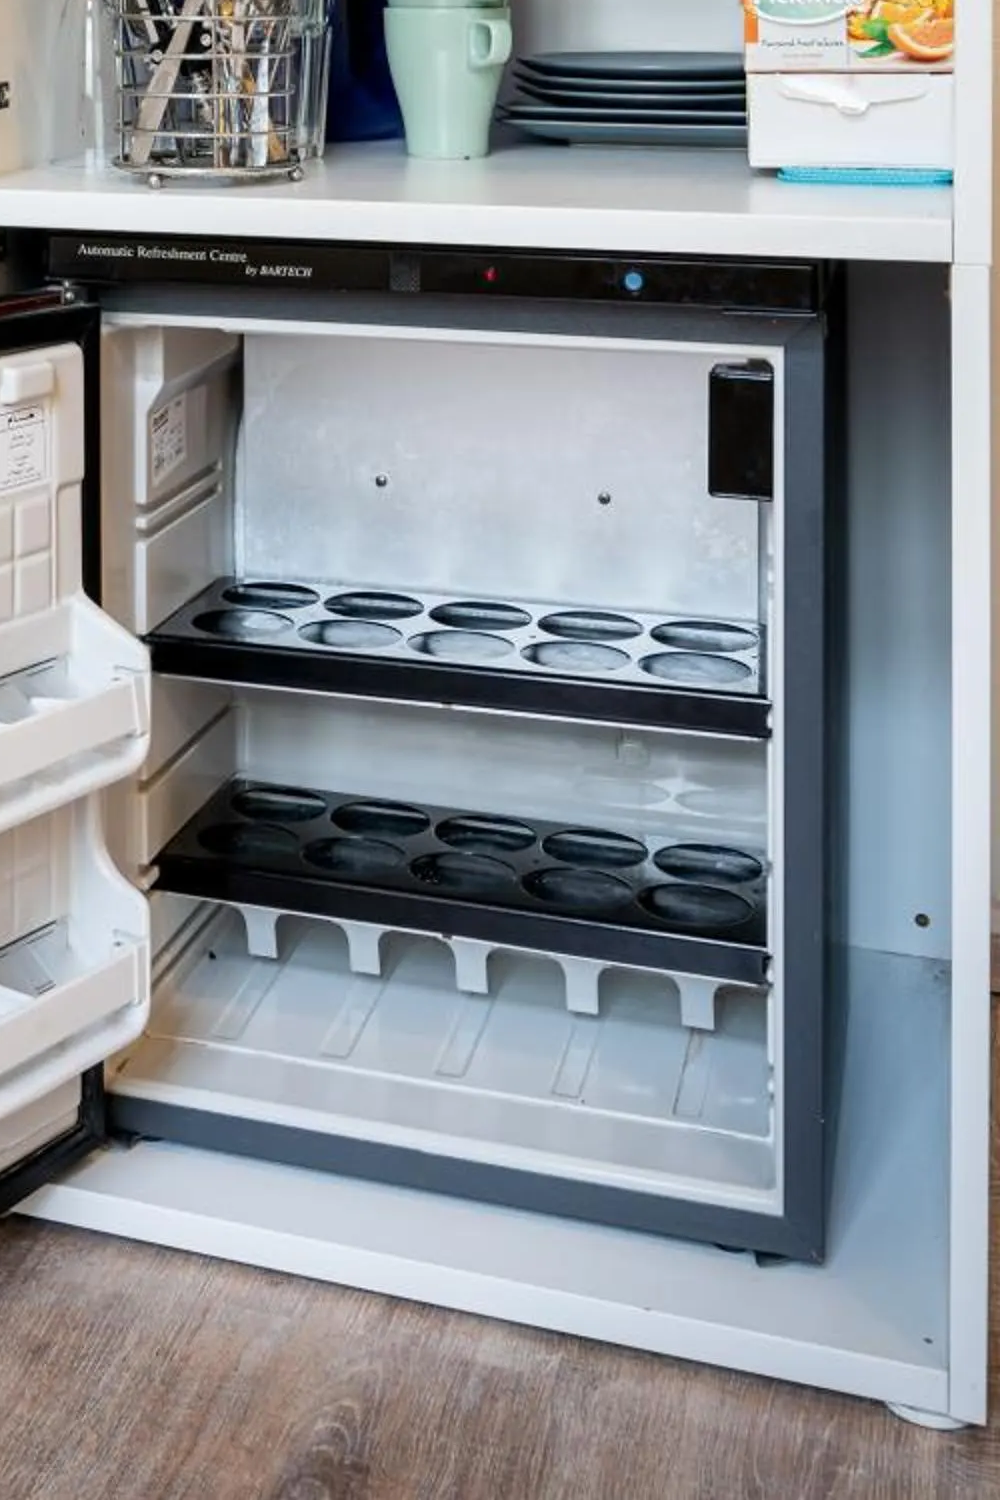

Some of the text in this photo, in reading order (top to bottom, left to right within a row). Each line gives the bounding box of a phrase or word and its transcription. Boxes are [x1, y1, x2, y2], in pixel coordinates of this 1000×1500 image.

[78, 243, 248, 263] Automatic Refreshment Centre
[245, 264, 313, 277] by BARTECH
